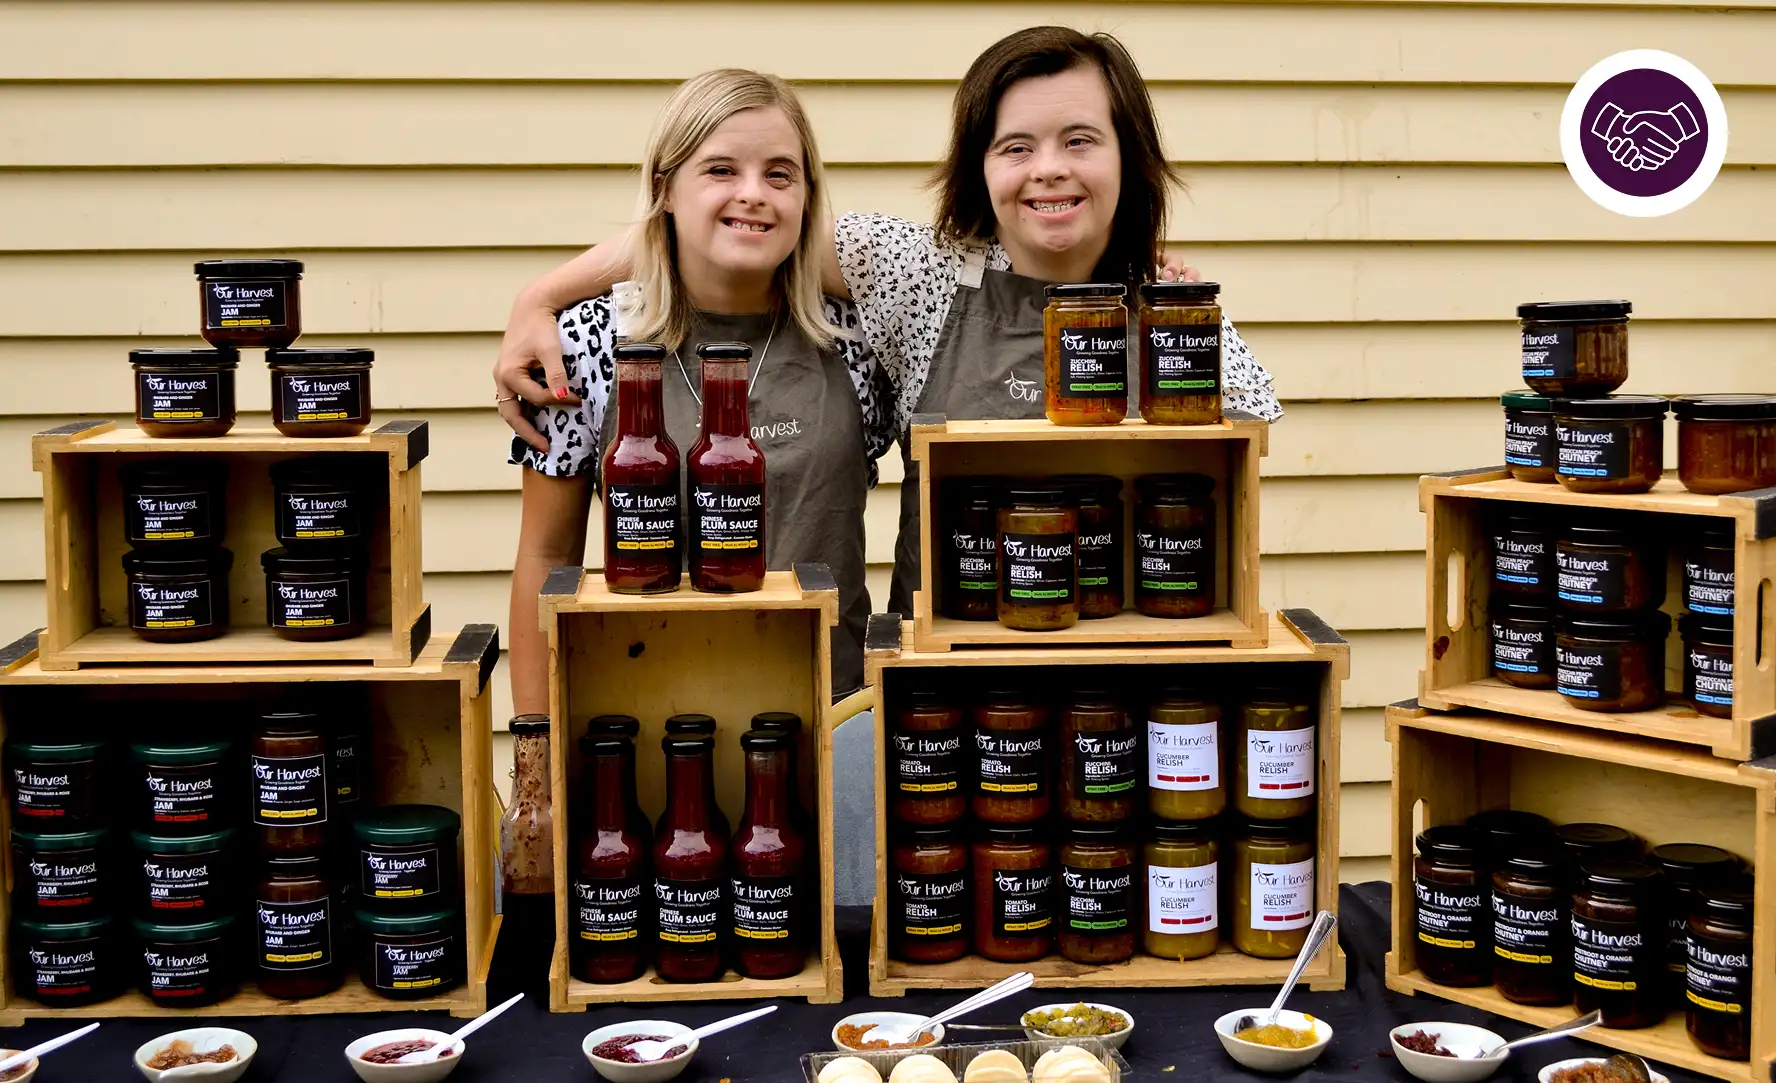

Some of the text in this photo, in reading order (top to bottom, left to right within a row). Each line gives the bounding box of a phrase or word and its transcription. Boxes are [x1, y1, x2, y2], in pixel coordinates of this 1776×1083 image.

[214, 286, 274, 298] Our Harvest
[221, 308, 239, 316] JAM
[1063, 336, 1126, 350] Our Harvest
[1151, 333, 1218, 348] Our Harvest
[1526, 333, 1559, 344] Harvest
[1070, 363, 1102, 371] RELISH
[1159, 360, 1190, 369] RELISH
[148, 378, 207, 391] Our Harvest
[291, 379, 351, 392] Our Harvest
[1008, 378, 1042, 402] Our
[298, 402, 317, 410] JAM
[750, 419, 801, 439] arvest
[1513, 422, 1548, 435] Harvest
[1572, 430, 1614, 443] Harvest
[1559, 454, 1598, 462] CHUTNEY
[138, 498, 197, 510] Our Harvest
[290, 498, 348, 510] Our Harvest
[611, 494, 677, 508] Our Harvest
[695, 494, 761, 508] Our Harvest
[617, 520, 674, 530] PLUM SAUCE
[701, 520, 758, 529] PLUM SAUCE
[1137, 535, 1202, 550] Our Harvest
[1506, 540, 1544, 553] Harvest
[1004, 542, 1027, 555] Our
[1031, 544, 1072, 557] Harvest
[960, 562, 991, 570] RELISH
[1142, 562, 1170, 571] RELISH
[1496, 561, 1528, 571] CHUTNEY
[1570, 557, 1609, 571] Harvest
[1011, 570, 1042, 579] RELISH
[1558, 578, 1592, 589] CHUTNEY
[140, 587, 199, 600] Our Harvest
[279, 587, 338, 598] Our Harvest
[1690, 590, 1729, 601] CHUTNEY
[1506, 629, 1544, 642] Harvest
[1495, 650, 1528, 660] CHUTNEY
[1566, 652, 1603, 666] Harvest
[1151, 730, 1214, 746] Our Harvest
[895, 738, 960, 752] Our Harvest
[976, 738, 1041, 752] Our Harvest
[1078, 738, 1101, 753] Our
[1253, 739, 1312, 754] Our Harvest
[900, 765, 930, 773] RELISH
[981, 764, 1011, 773] RELISH
[1085, 765, 1117, 774] RELISH
[1157, 759, 1183, 767] RELISH
[30, 774, 70, 786] Harvest
[255, 766, 321, 781] Our Harvest
[148, 778, 212, 792] Our Harvest
[260, 792, 278, 800] JAM
[154, 802, 173, 810] JAM
[31, 862, 97, 876] Our Harvest
[370, 856, 427, 870] Our Harvest
[145, 864, 208, 879] Our Harvest
[999, 877, 1022, 892] Our
[1065, 874, 1130, 890] Our Harvest
[1154, 874, 1214, 888] Our Harvest
[1257, 871, 1313, 886] Our Harvest
[38, 886, 57, 894] JAM
[151, 888, 169, 896] JAM
[600, 884, 640, 901] Harvest
[655, 885, 720, 902] Our Harvest
[749, 885, 793, 899] Harvest
[899, 879, 964, 896] Our Harvest
[1415, 886, 1481, 906] Our Harvest
[1005, 903, 1036, 912] RELISH
[1070, 901, 1101, 910] RELISH
[1492, 900, 1558, 921] Our Harvest
[259, 910, 326, 925] Our Harvest
[581, 910, 638, 922] PLUM SAUCE
[660, 912, 717, 924] PLUM SAUCE
[734, 907, 788, 920] PLUM SAUCE
[906, 908, 937, 917] RELISH
[266, 936, 283, 944] JAM
[1570, 926, 1642, 946] Our Harvest
[30, 951, 95, 965] Our Harvest
[146, 953, 209, 967] Our Harvest
[388, 947, 444, 960] Our Harvest
[1575, 953, 1608, 967] CHUTNEY
[1697, 946, 1748, 967] Harvest
[37, 975, 55, 983] JAM
[152, 977, 170, 985] JAM
